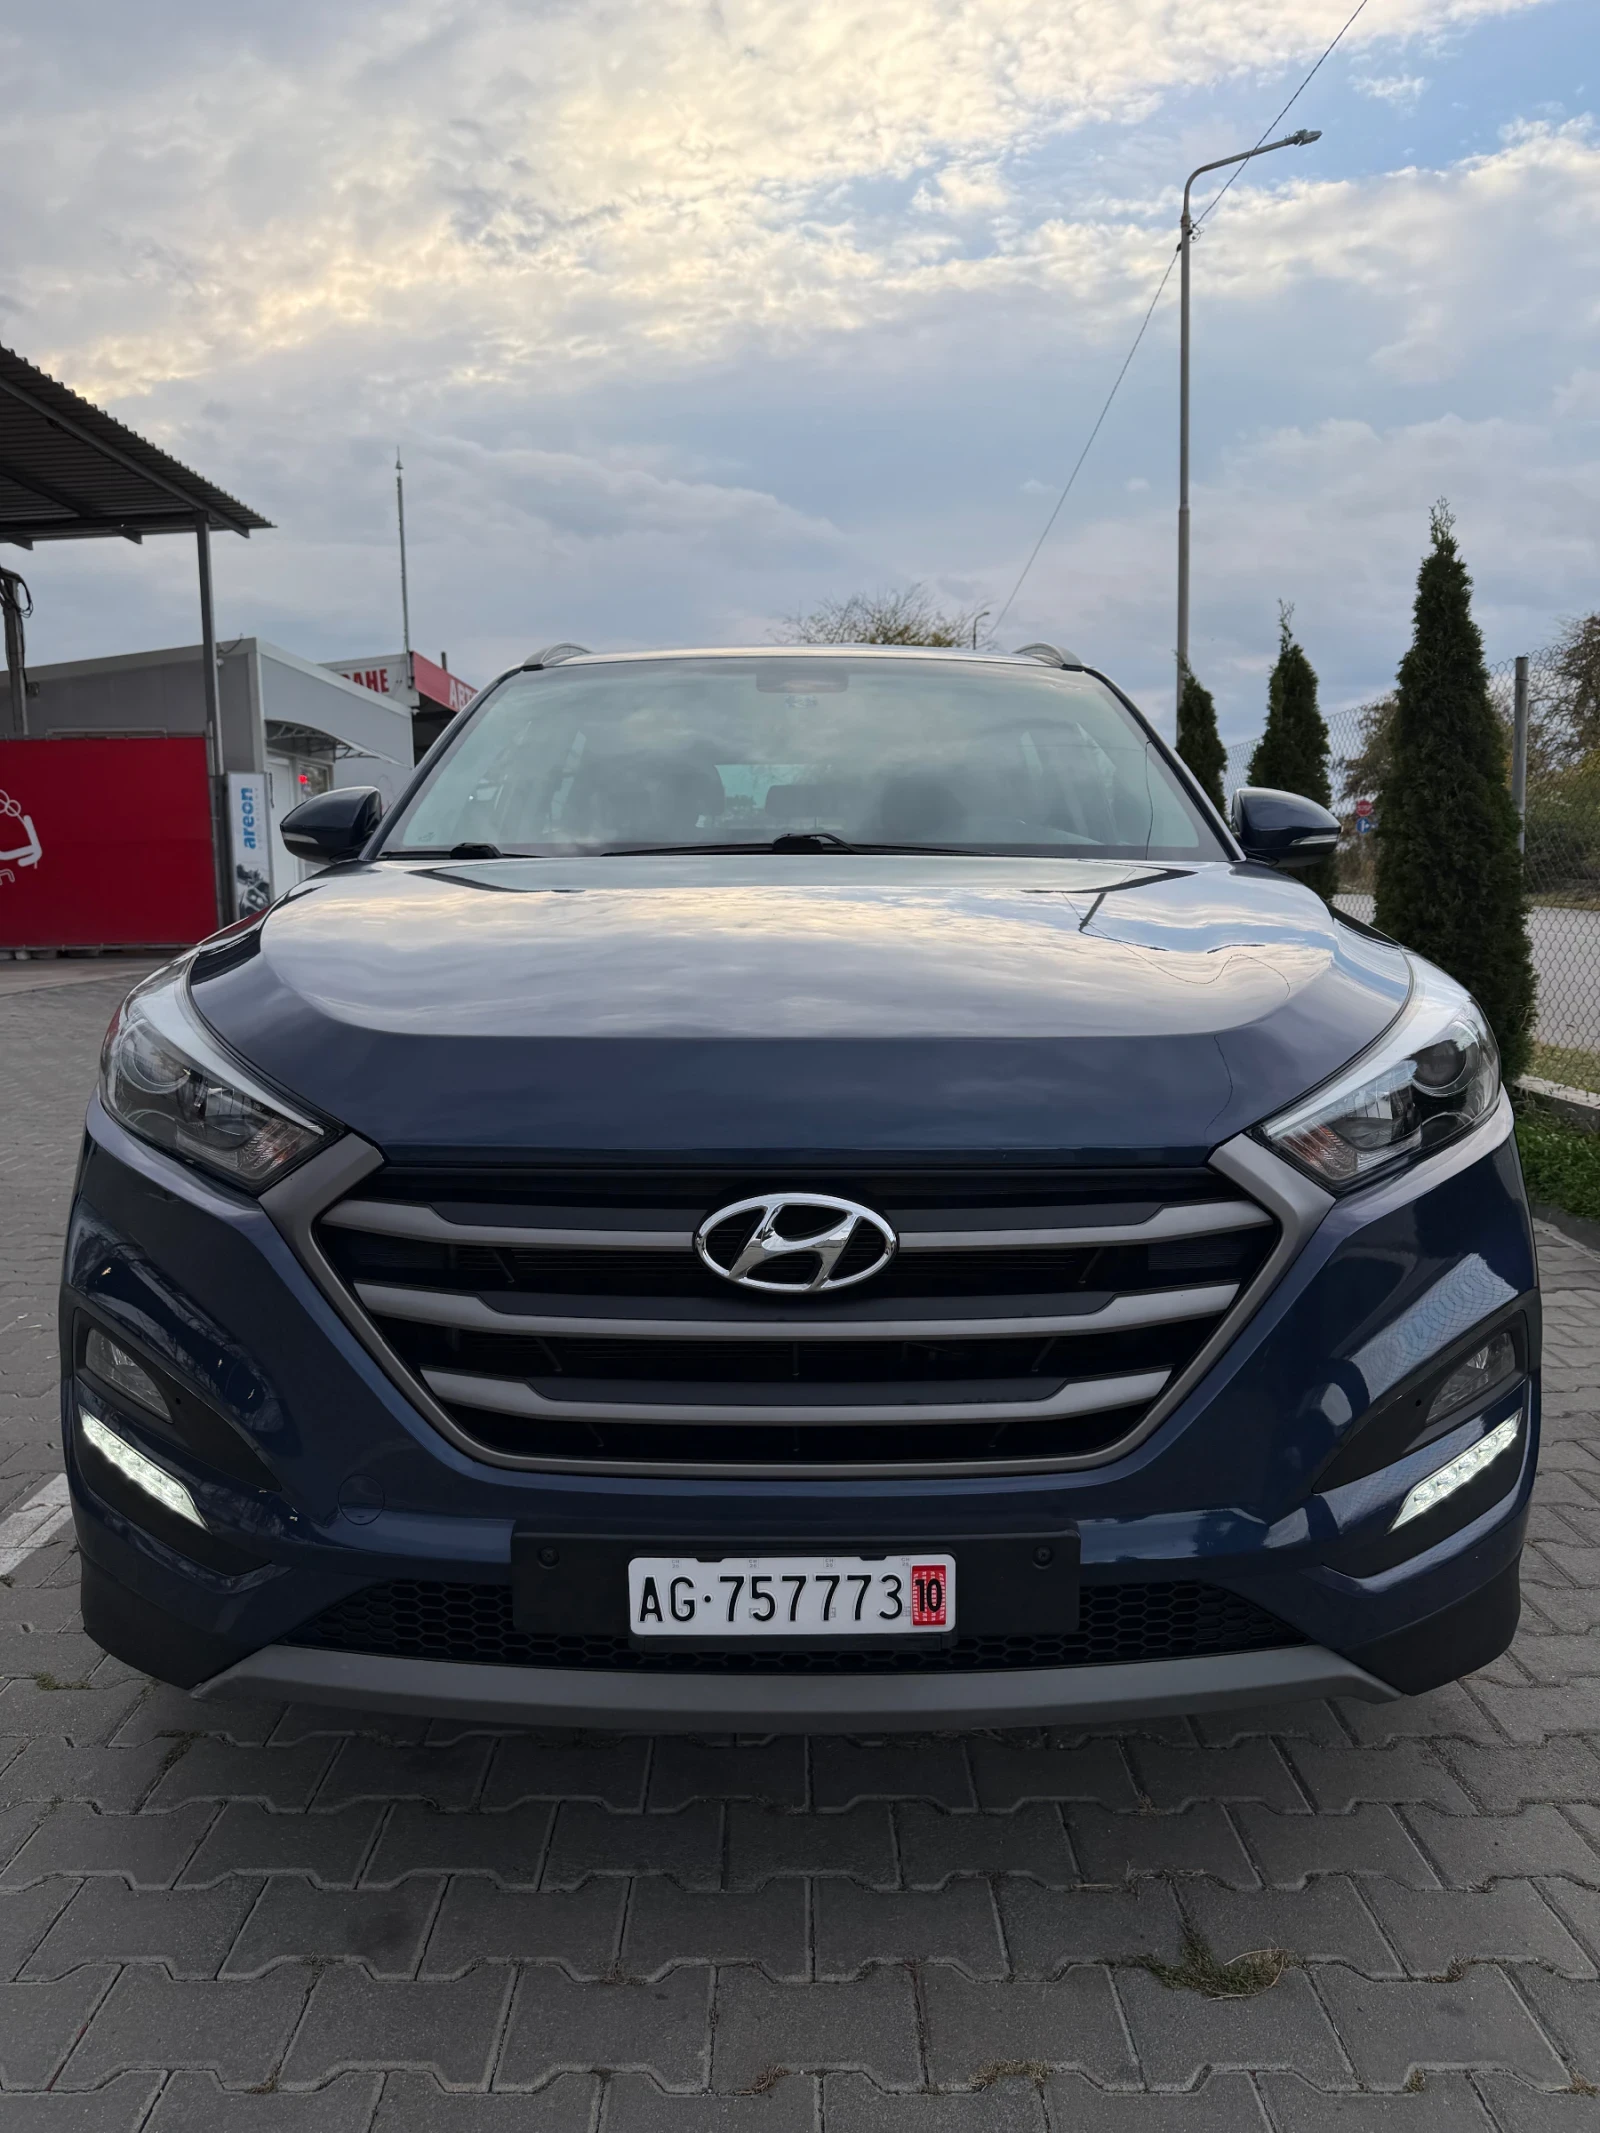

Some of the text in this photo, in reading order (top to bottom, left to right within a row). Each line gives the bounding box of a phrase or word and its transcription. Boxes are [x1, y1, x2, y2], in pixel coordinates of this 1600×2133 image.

[340, 668, 390, 693] АНЕ
[241, 787, 257, 850] areon
[915, 1579, 942, 1612] 10
